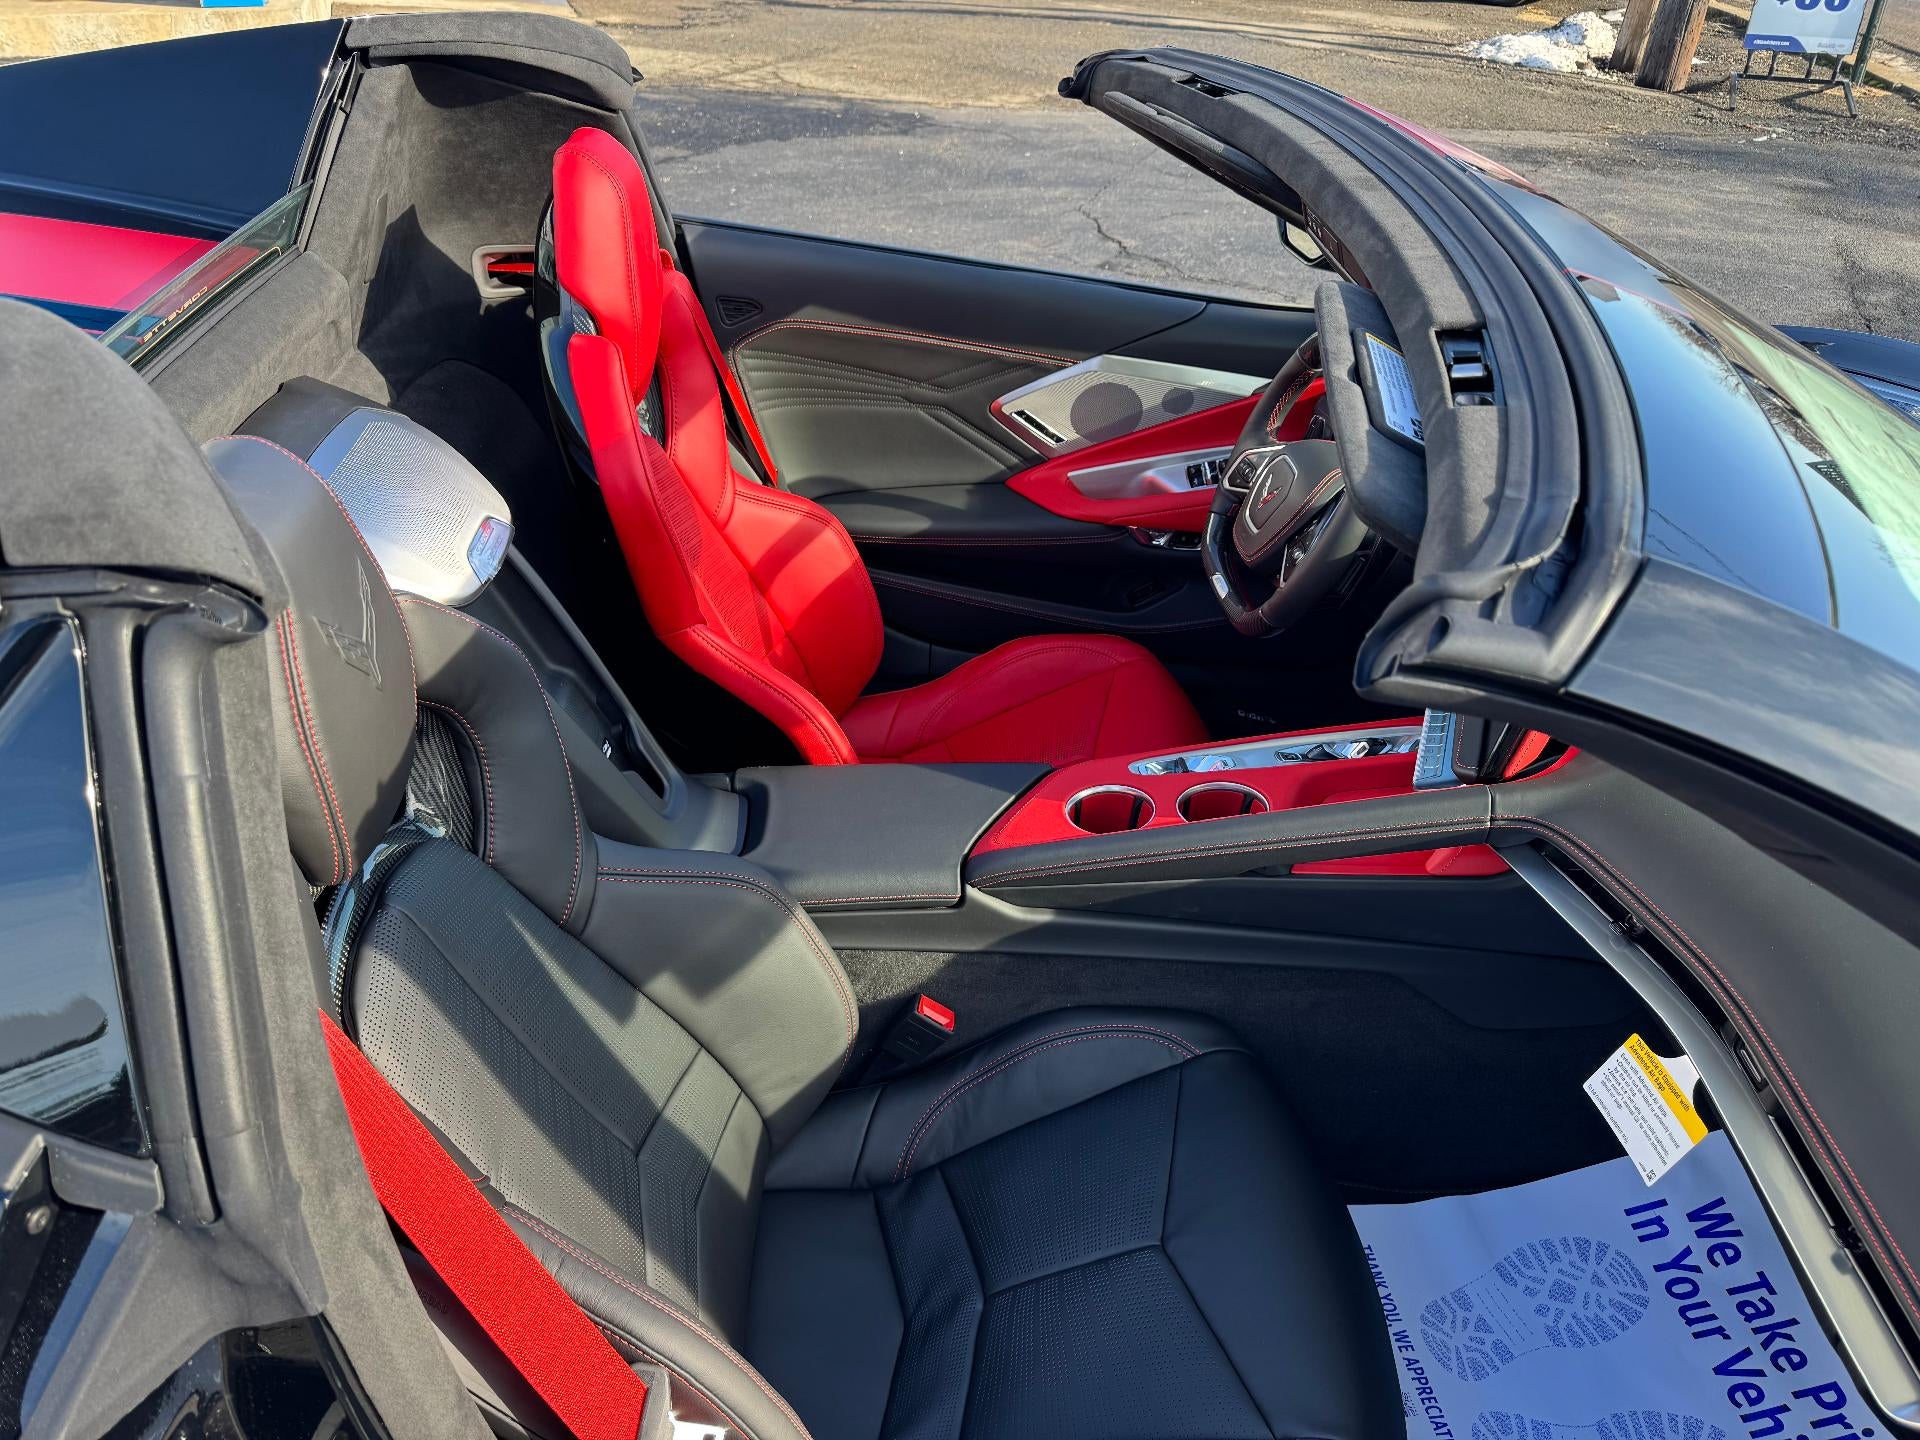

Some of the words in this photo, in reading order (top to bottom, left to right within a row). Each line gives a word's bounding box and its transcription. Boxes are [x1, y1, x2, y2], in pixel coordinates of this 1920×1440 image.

[1629, 1043, 1650, 1071] Advanced
[1647, 1068, 1656, 1078] Air
[1652, 1076, 1666, 1093] Bags
[1634, 1038, 1646, 1052] This
[1643, 1049, 1660, 1070] Vehicle
[1660, 1073, 1681, 1101] Equipped
[1678, 1097, 1690, 1112] with
[1363, 1244, 1388, 1291] THANK
[1686, 1196, 1743, 1268] We
[1726, 1270, 1808, 1374] Take
[1393, 1329, 1415, 1352] WE
[1624, 1198, 1670, 1242] In
[1653, 1245, 1731, 1340] Your
[1712, 1346, 1810, 1440] Veh
[1403, 1356, 1455, 1440] APPRECIAT
